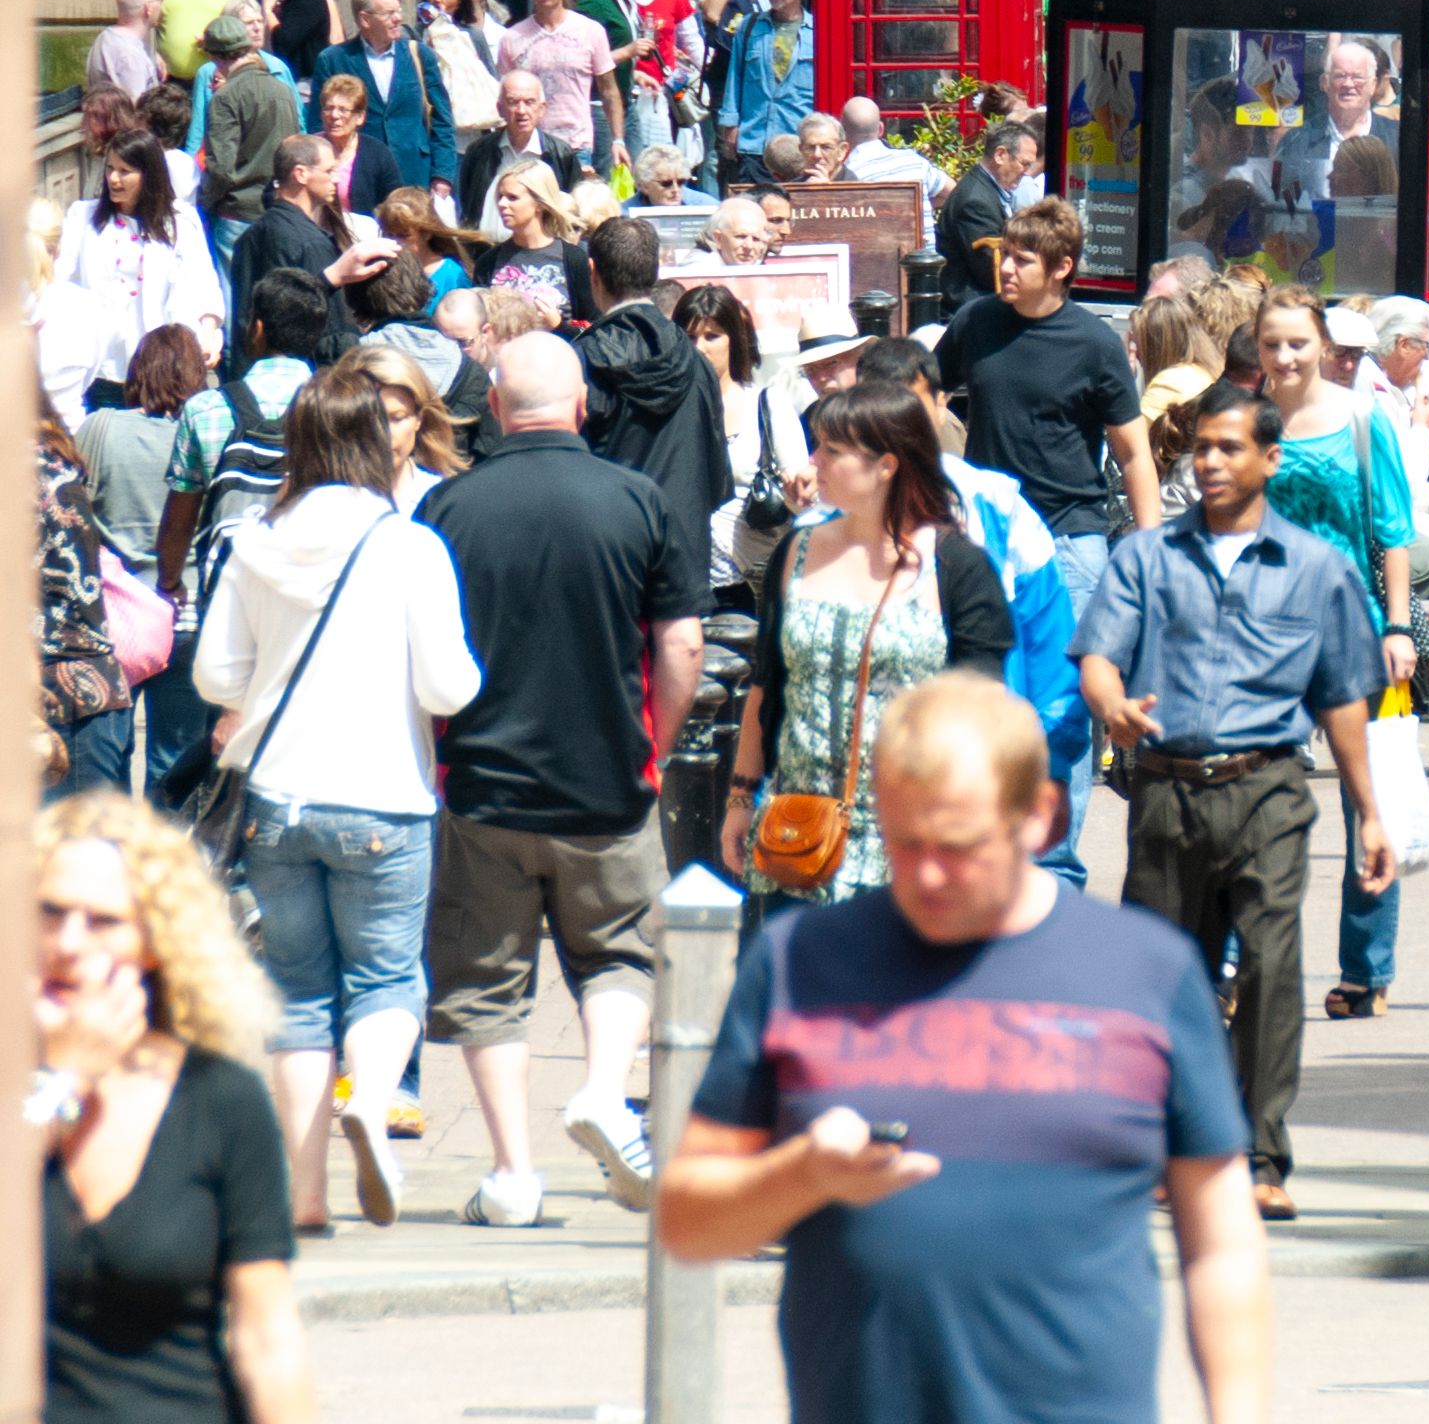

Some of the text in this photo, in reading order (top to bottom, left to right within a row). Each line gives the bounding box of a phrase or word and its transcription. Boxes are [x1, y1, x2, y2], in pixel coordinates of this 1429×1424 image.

[825, 206, 877, 219] ITALIA
[1095, 224, 1126, 235] cream
[1100, 244, 1122, 255] corn
